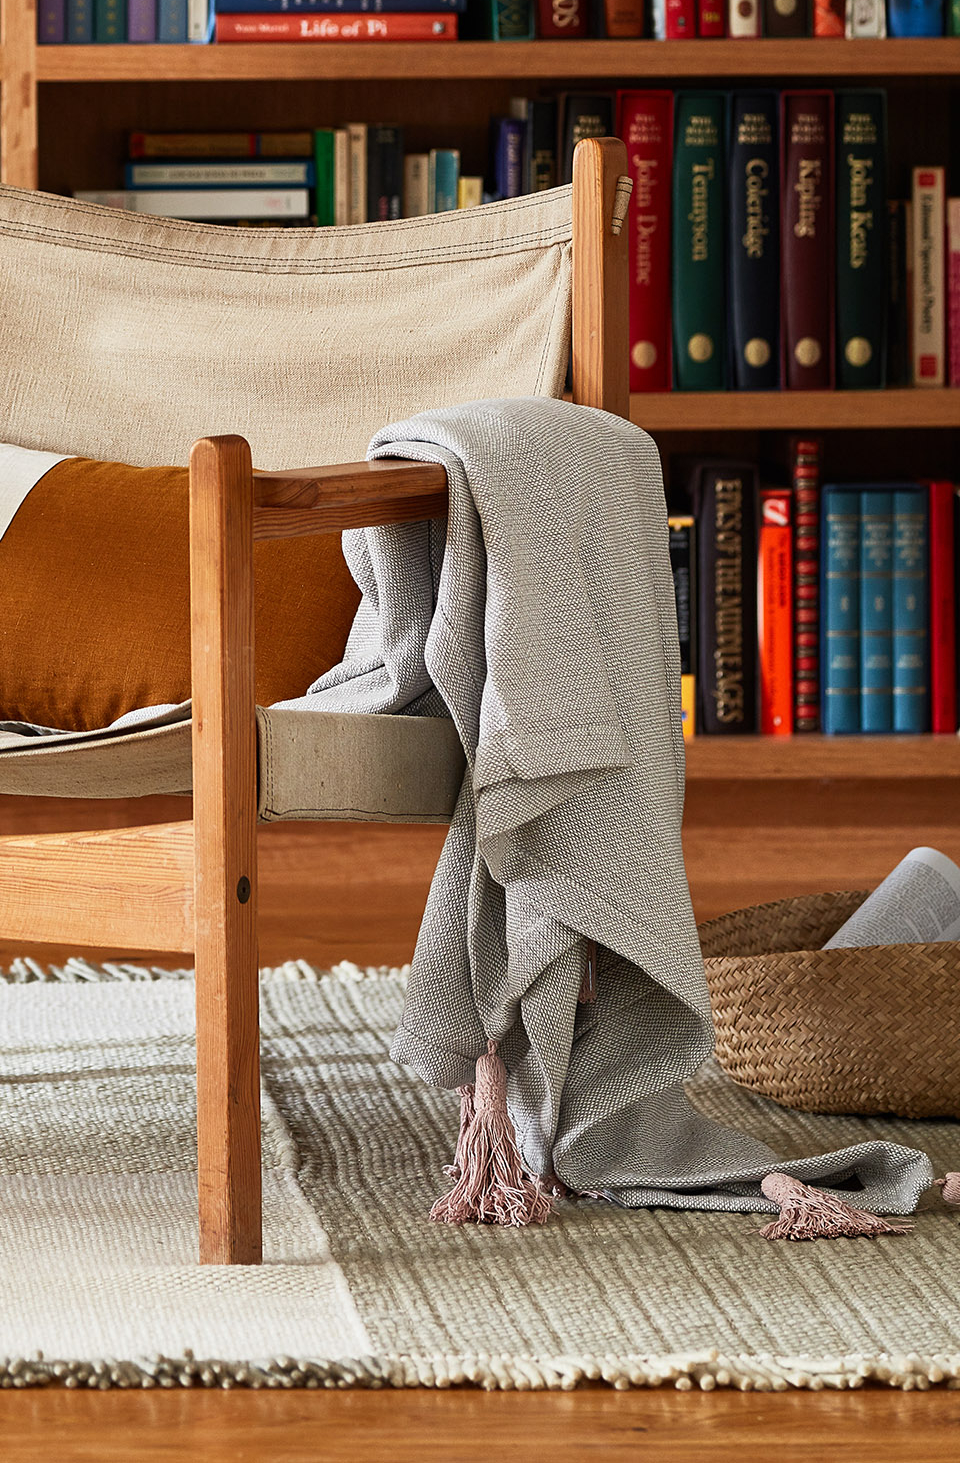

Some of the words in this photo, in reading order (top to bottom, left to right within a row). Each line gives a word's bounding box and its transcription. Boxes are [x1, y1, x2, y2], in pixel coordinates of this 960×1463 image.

[300, 20, 339, 36] Life
[341, 22, 359, 36] of
[367, 19, 387, 36] Pi
[634, 155, 657, 208] John
[742, 158, 769, 258] Coleridge
[794, 159, 822, 238] Kipling
[847, 154, 873, 206] John
[687, 159, 715, 262] Tennyson
[636, 214, 657, 285] Donne
[849, 211, 874, 269] Keats
[714, 478, 742, 530] EPICS
